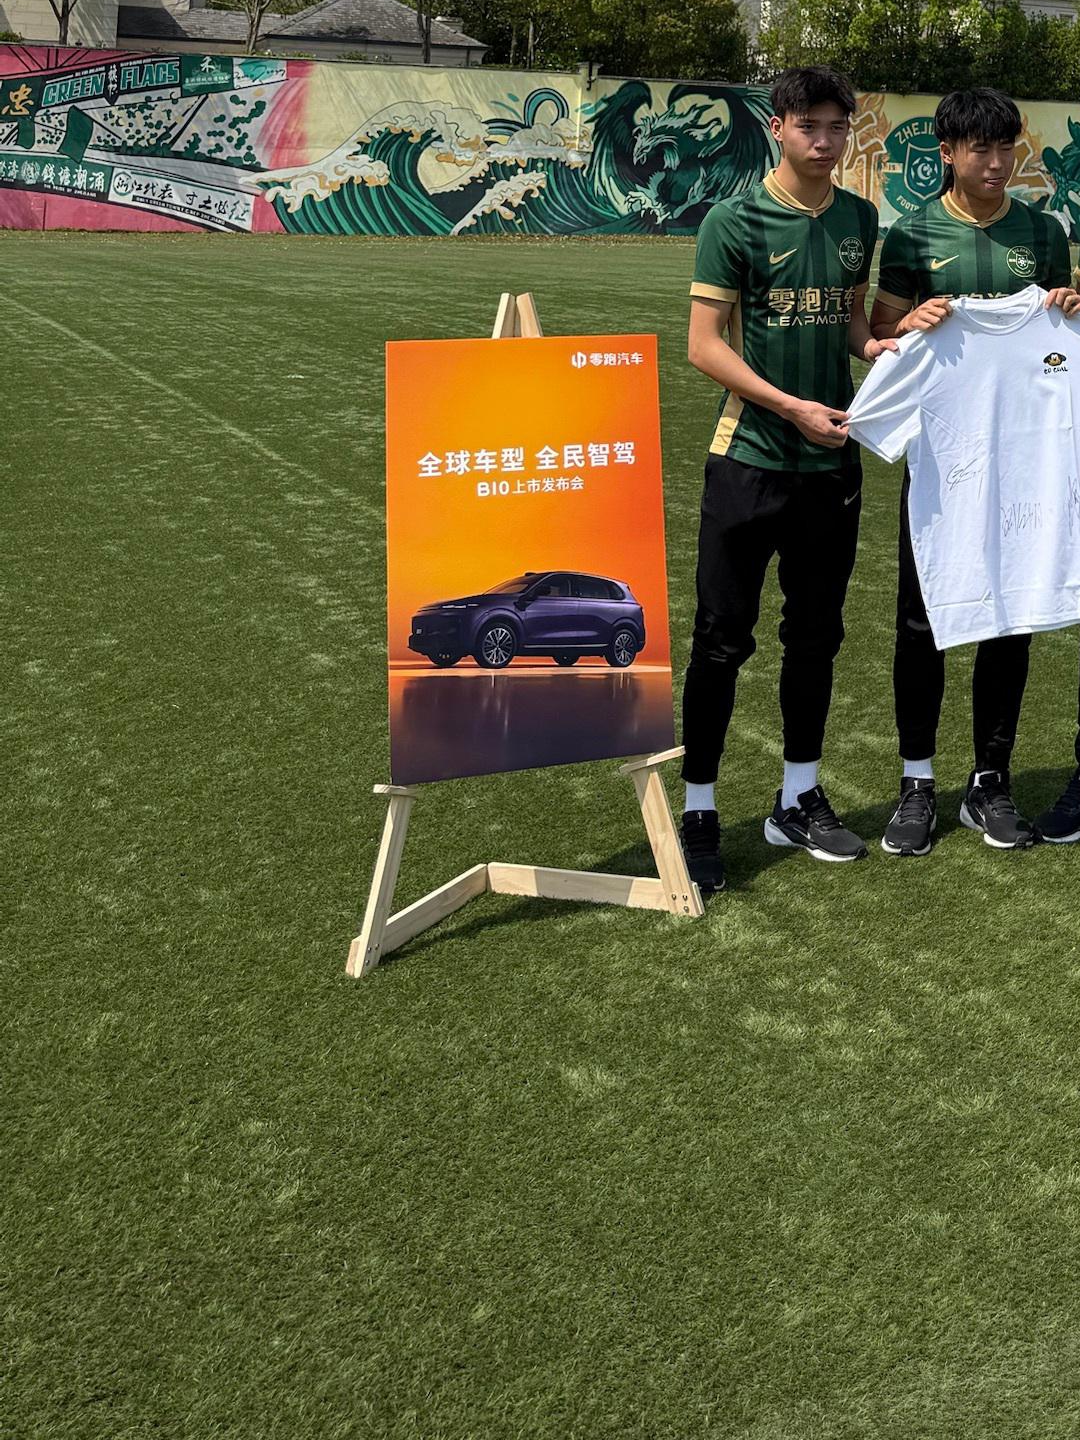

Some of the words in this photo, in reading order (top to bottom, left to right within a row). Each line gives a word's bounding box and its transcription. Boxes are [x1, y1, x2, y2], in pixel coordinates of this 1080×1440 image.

[41, 72, 106, 107] GREEN
[120, 60, 180, 91] FLAGS
[1, 83, 35, 115] 忠
[894, 121, 935, 145] ZHEJI
[767, 312, 851, 327] LEAPMOTO
[589, 351, 643, 367] 零跑汽车
[417, 446, 525, 478] 全球车型
[534, 440, 636, 471] 全民智驾
